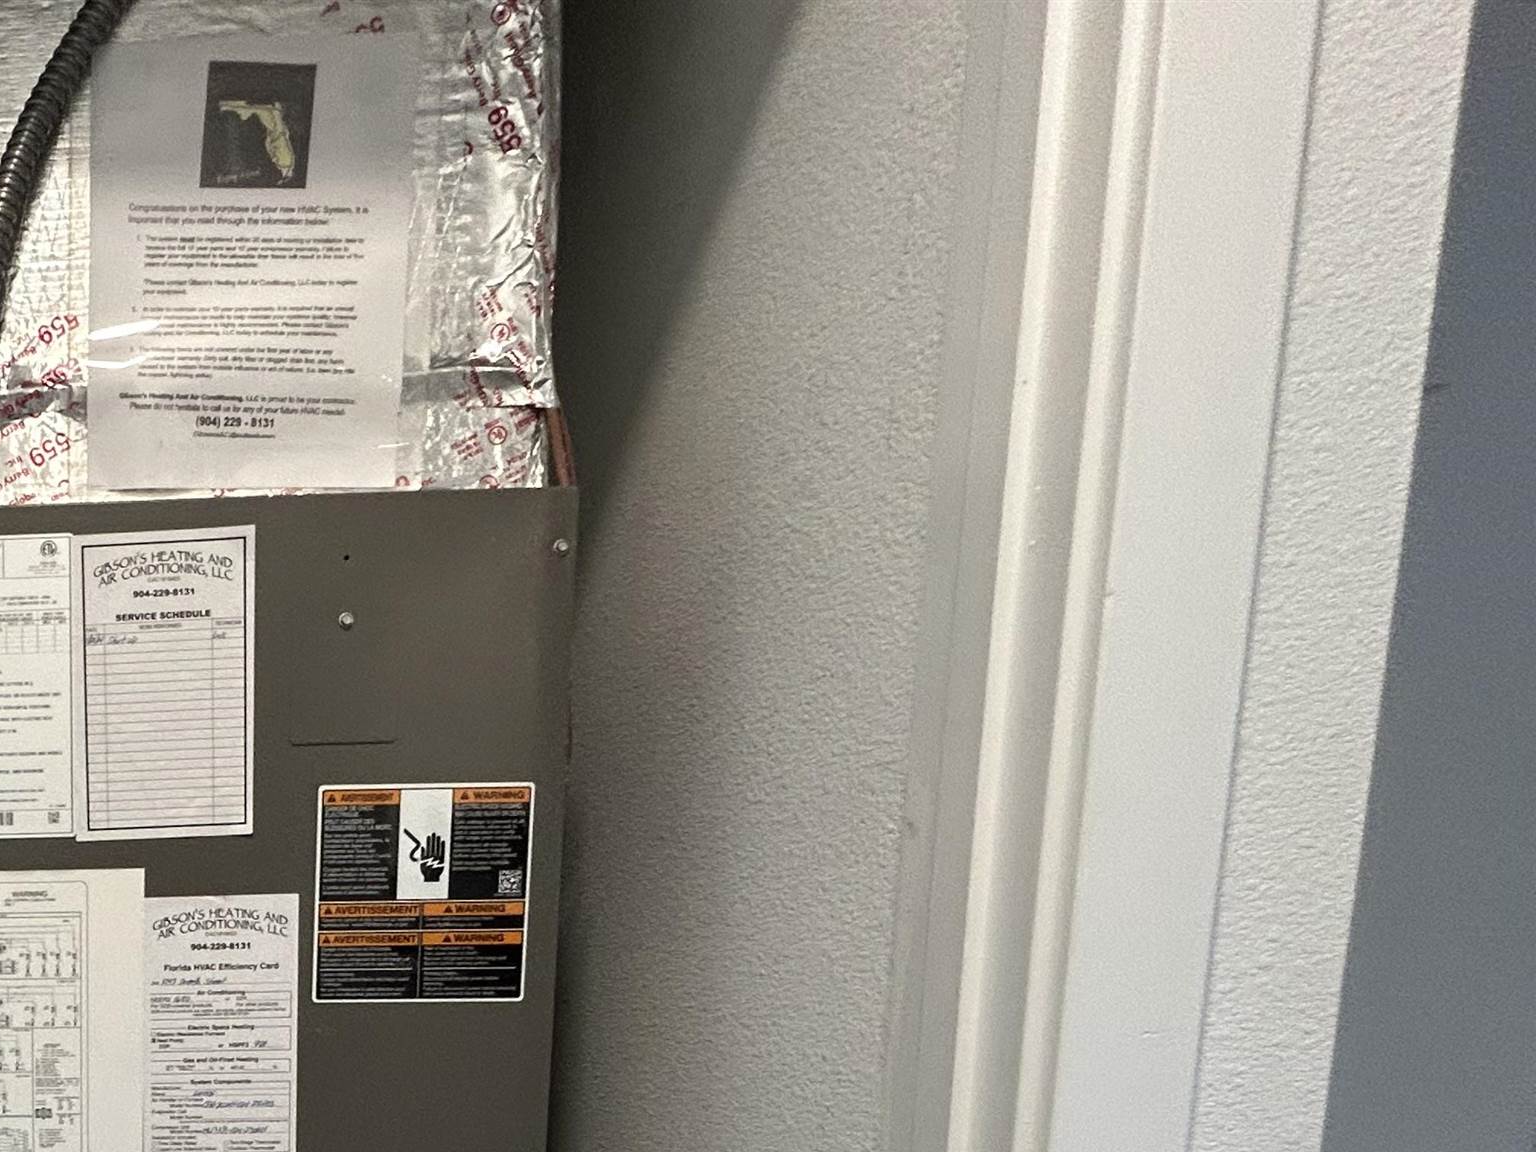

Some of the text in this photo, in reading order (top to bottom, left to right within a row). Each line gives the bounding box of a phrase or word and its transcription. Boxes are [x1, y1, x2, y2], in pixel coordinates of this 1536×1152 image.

[488, 106, 522, 154] 559
[214, 206, 249, 214] purchase
[217, 217, 245, 227] through
[196, 416, 221, 429] (904)
[224, 416, 242, 427] 229
[251, 417, 274, 428] 8131
[1, 420, 26, 437] Berry
[30, 432, 71, 467] 559
[93, 550, 233, 578] GIBSON'S HEATING AND
[98, 572, 117, 589] AIR
[121, 562, 208, 580] CONDITIONING,
[212, 567, 233, 581] LLC
[133, 588, 195, 598] 904-229-8131
[116, 609, 211, 621] SERVICE SCHEDULE
[474, 791, 524, 800] WARNING
[335, 905, 418, 915] AVERTISSEMENT
[455, 904, 506, 913] WARNING
[153, 908, 288, 930] GIBSON'S HEATING AND
[158, 926, 175, 941] AIR
[267, 923, 288, 937] LLC
[332, 935, 417, 943] AVERTISSEMENT
[454, 934, 505, 943] WARNING
[190, 942, 251, 951] 904-229-8131
[218, 963, 257, 972] Efficiency
